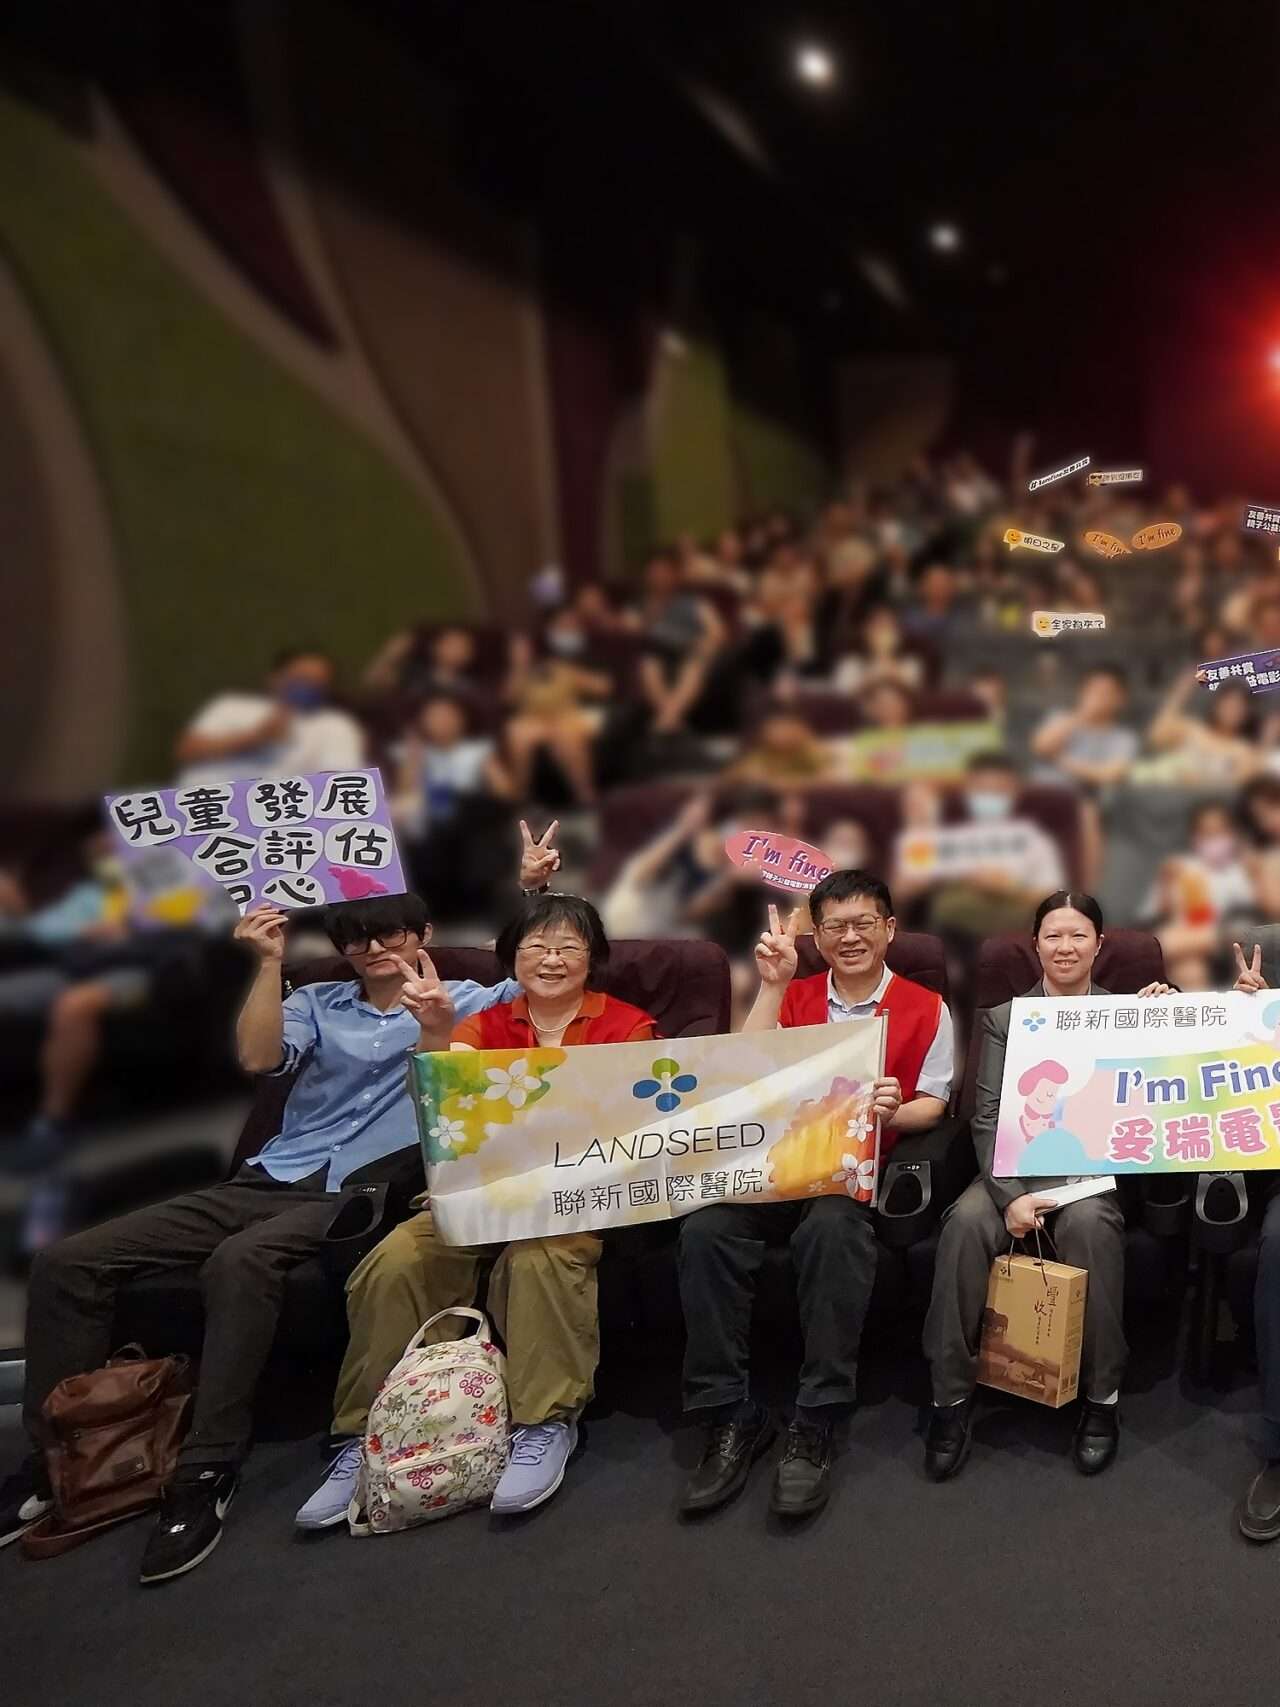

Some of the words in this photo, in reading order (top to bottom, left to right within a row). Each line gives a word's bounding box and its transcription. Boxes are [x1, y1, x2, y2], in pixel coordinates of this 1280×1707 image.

[1207, 661, 1255, 681] 友善共賞
[115, 777, 370, 841] 兒童發展
[742, 836, 782, 865] I'm
[788, 850, 831, 882] fine
[1056, 1005, 1227, 1030] 聯新國際醫院
[1117, 1069, 1186, 1104] I'm
[553, 1121, 766, 1169] LANDSEED
[552, 1168, 763, 1216] 聯新國際醫院
